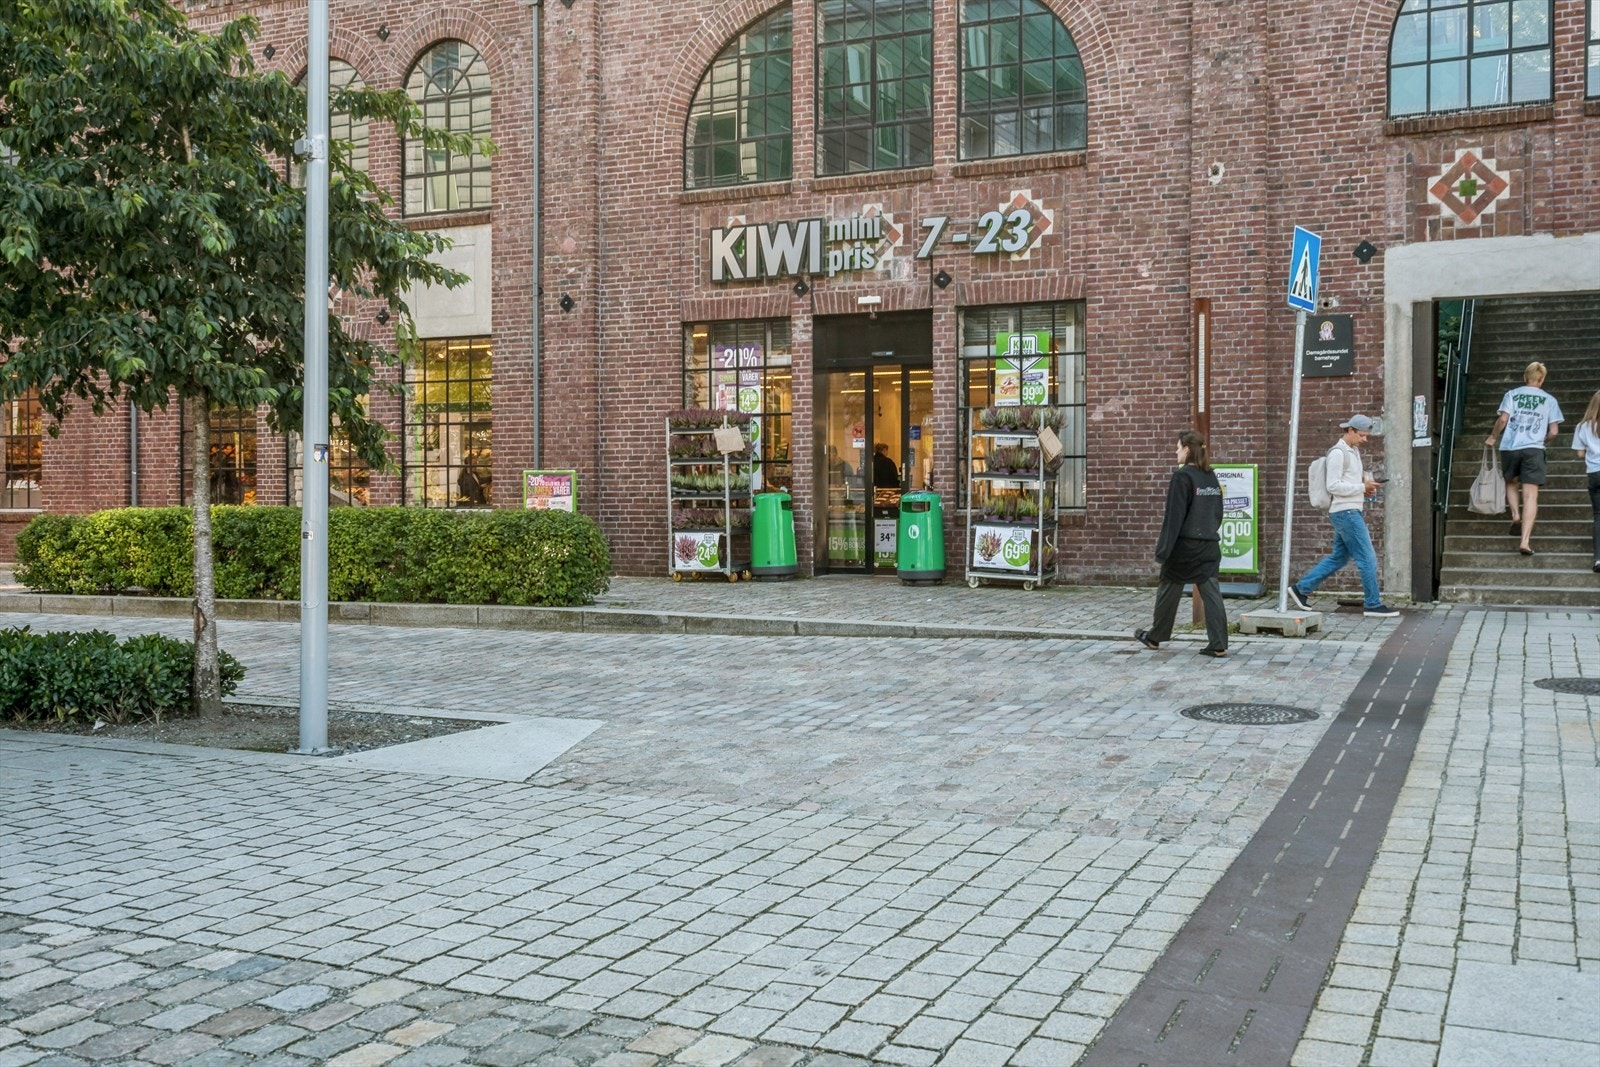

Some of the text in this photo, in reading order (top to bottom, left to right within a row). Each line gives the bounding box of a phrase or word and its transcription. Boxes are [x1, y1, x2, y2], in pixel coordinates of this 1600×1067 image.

[828, 210, 881, 241] mini
[711, 219, 822, 283] KIWI
[828, 242, 876, 277] pris
[1013, 340, 1033, 349] KWI
[719, 347, 757, 368] -20%
[742, 372, 759, 382] VARER
[1513, 394, 1546, 404] GREEN
[1517, 401, 1539, 410] DAY
[828, 536, 848, 551] 15%
